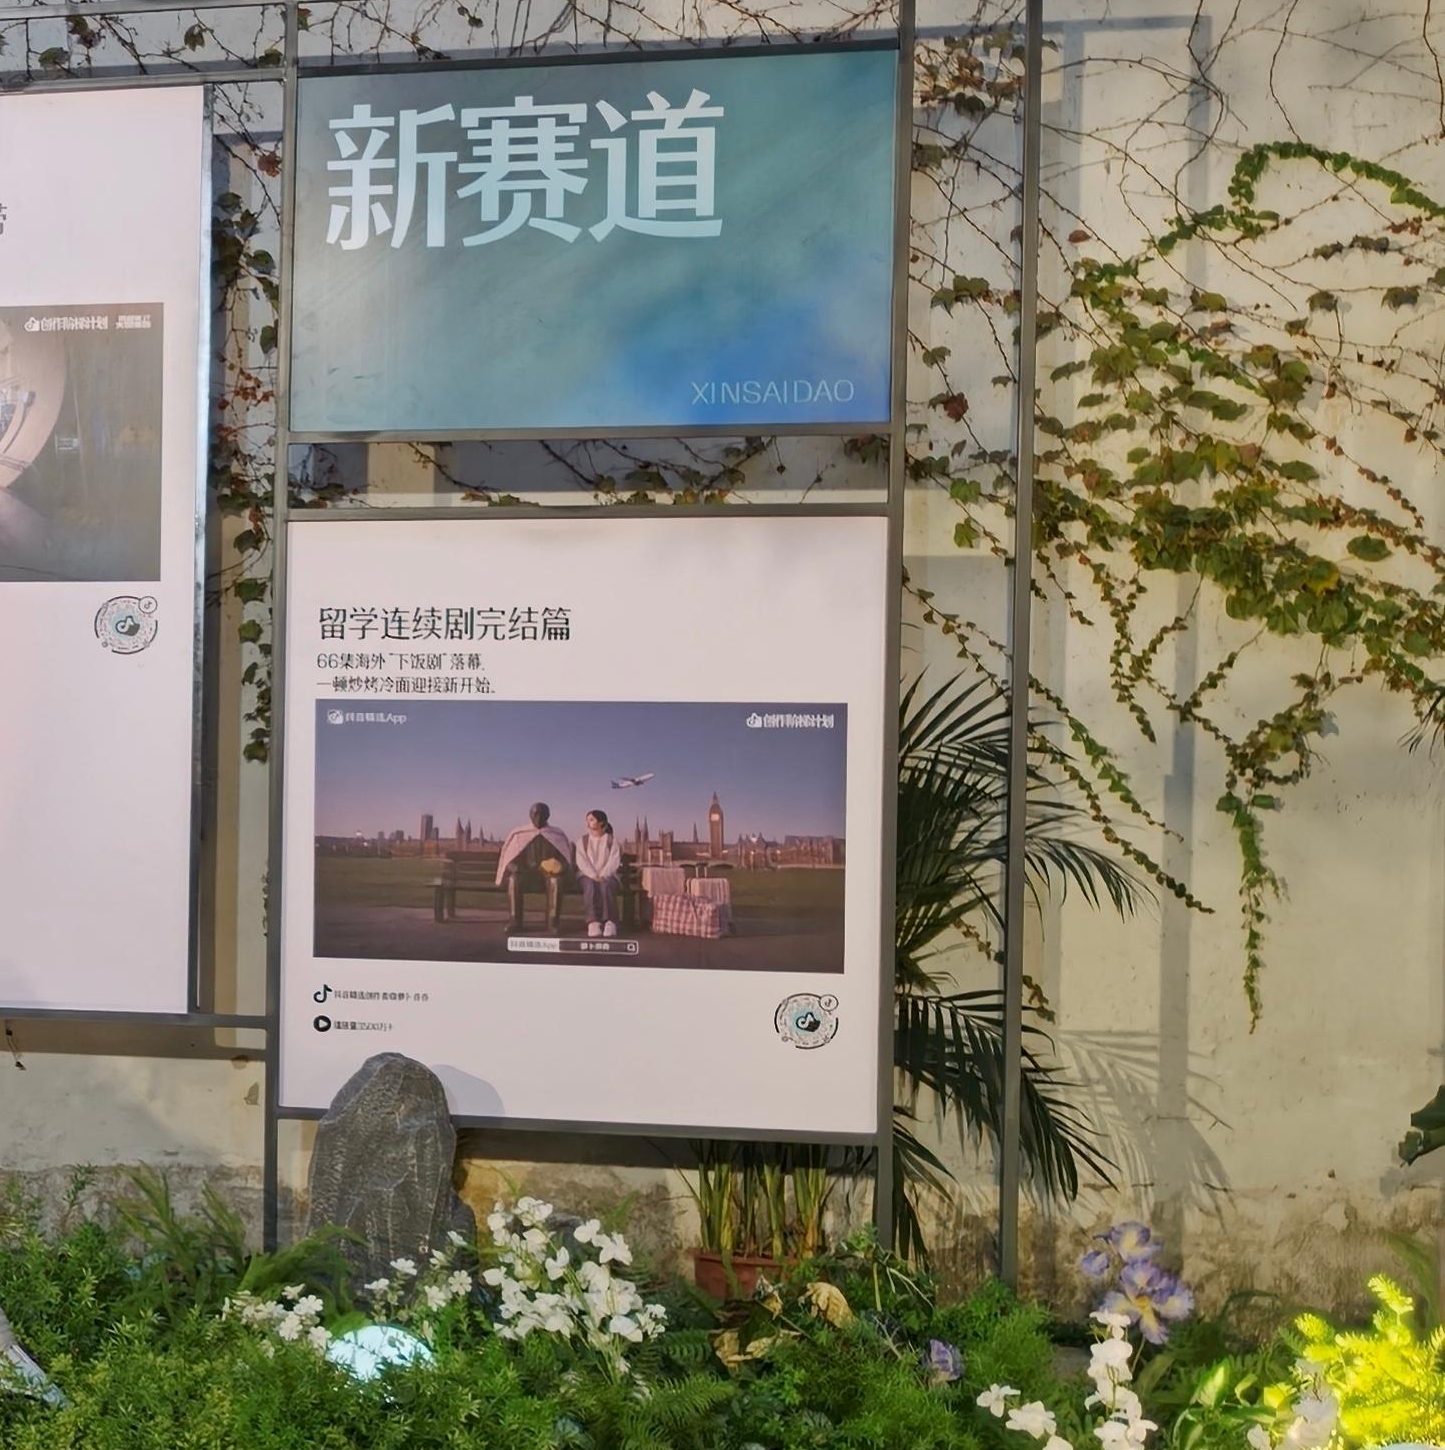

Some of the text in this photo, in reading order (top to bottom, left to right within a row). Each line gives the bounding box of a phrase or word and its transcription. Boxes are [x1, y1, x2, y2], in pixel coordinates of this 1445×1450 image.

[326, 88, 725, 250] 新赛道
[691, 379, 855, 406] XINSAIDAO
[318, 606, 572, 642] 留学连续剧完结篇
